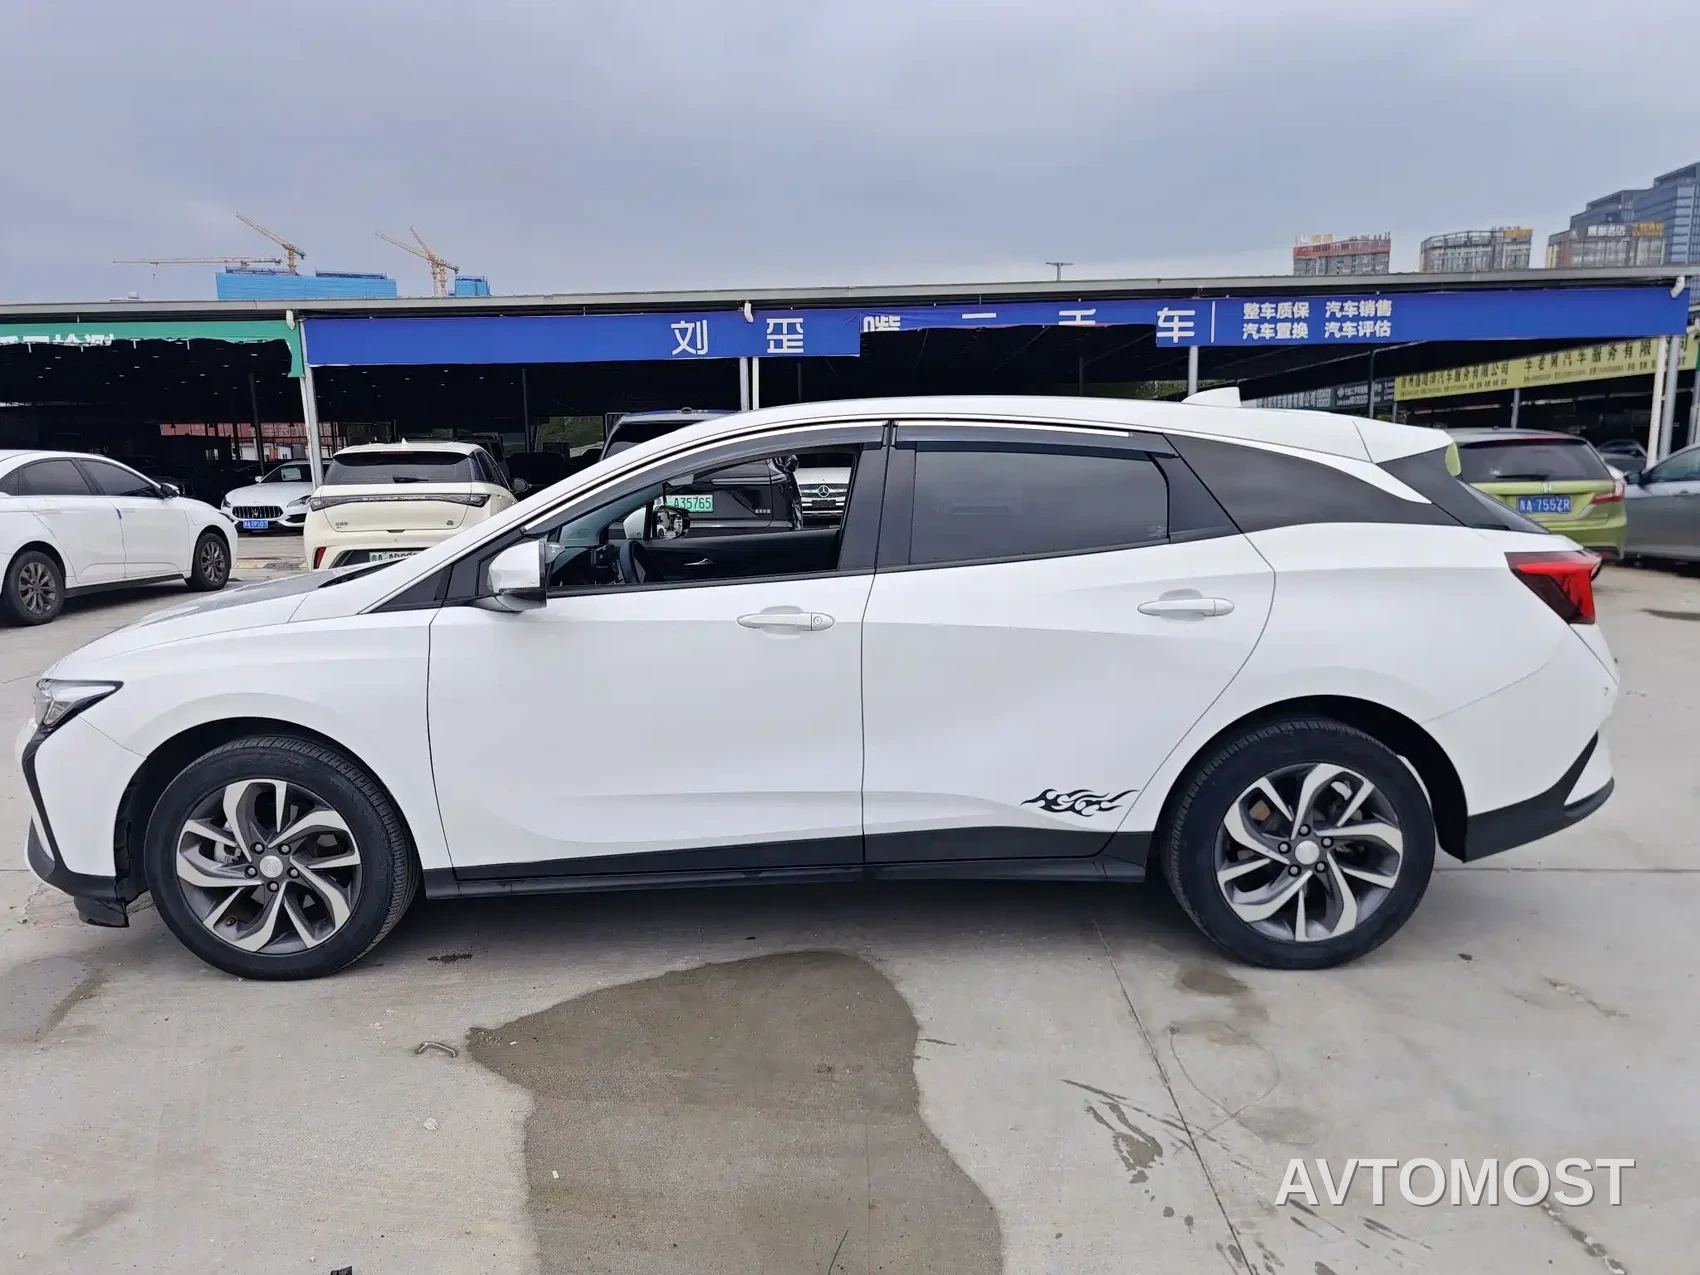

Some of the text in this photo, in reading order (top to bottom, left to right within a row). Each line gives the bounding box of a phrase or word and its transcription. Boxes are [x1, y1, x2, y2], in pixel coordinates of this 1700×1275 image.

[1243, 300, 1392, 319] 整车质保 汽车销售
[1242, 320, 1392, 340] 汽车置换 汽车评估
